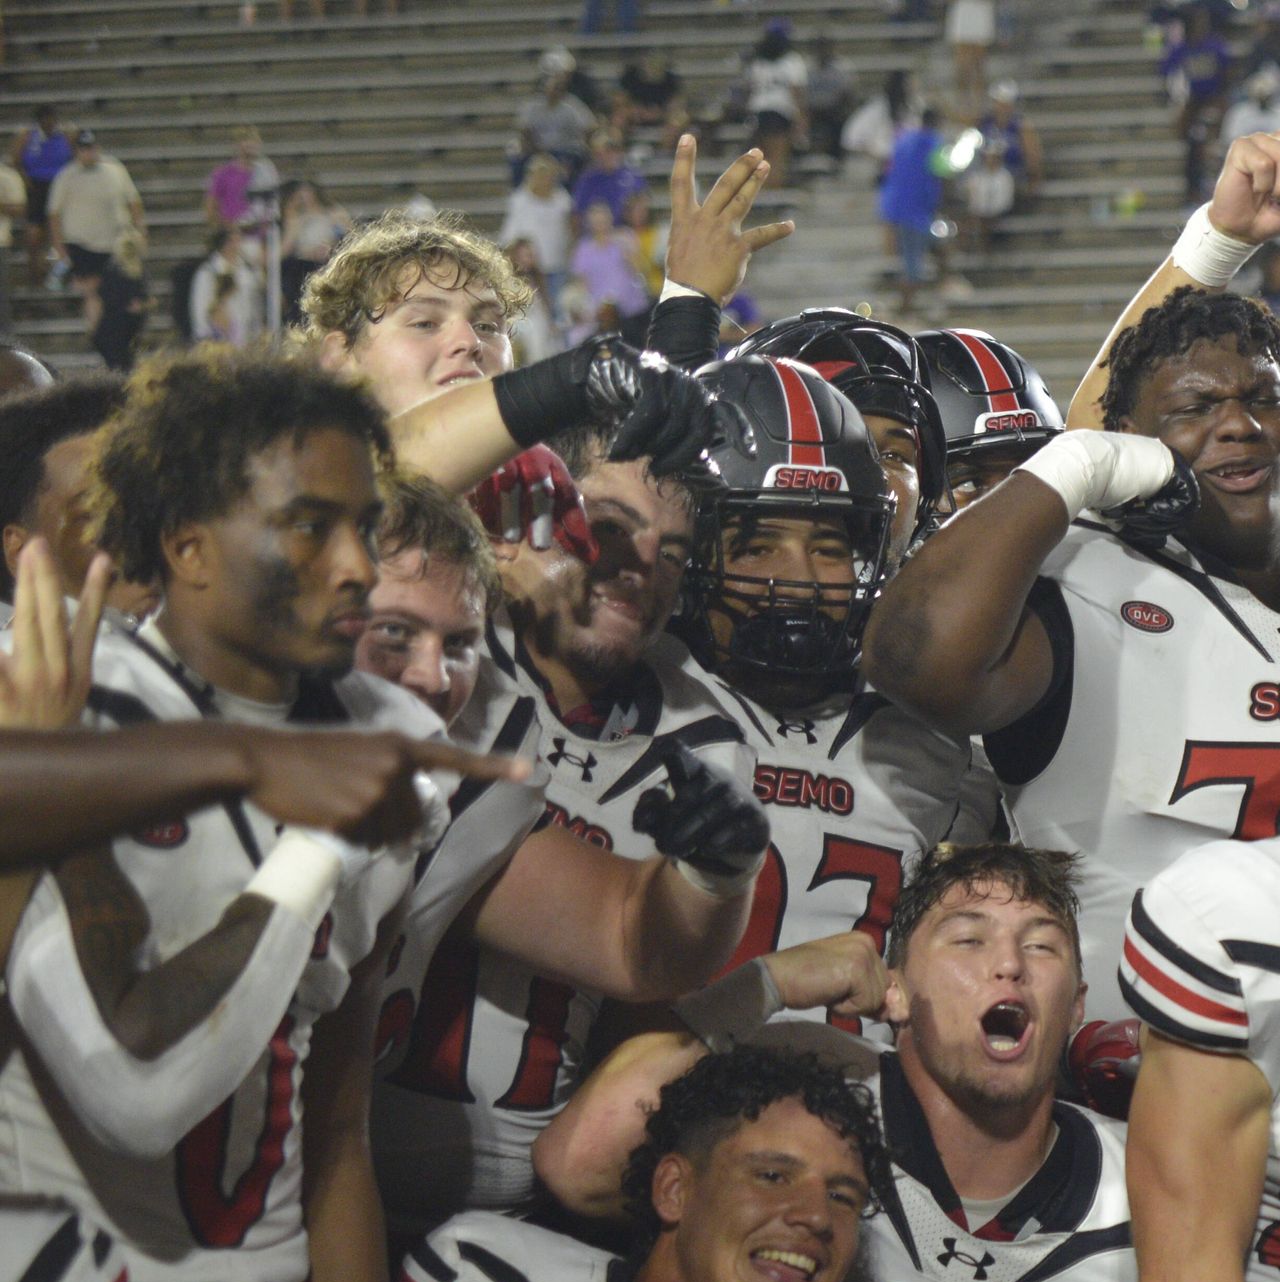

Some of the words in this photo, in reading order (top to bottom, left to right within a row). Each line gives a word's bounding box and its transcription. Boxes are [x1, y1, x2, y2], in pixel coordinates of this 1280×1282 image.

[986, 412, 1037, 430] SEMO
[776, 468, 841, 491] SEMO
[1133, 609, 1160, 624] OVC
[753, 764, 854, 815] SEMO
